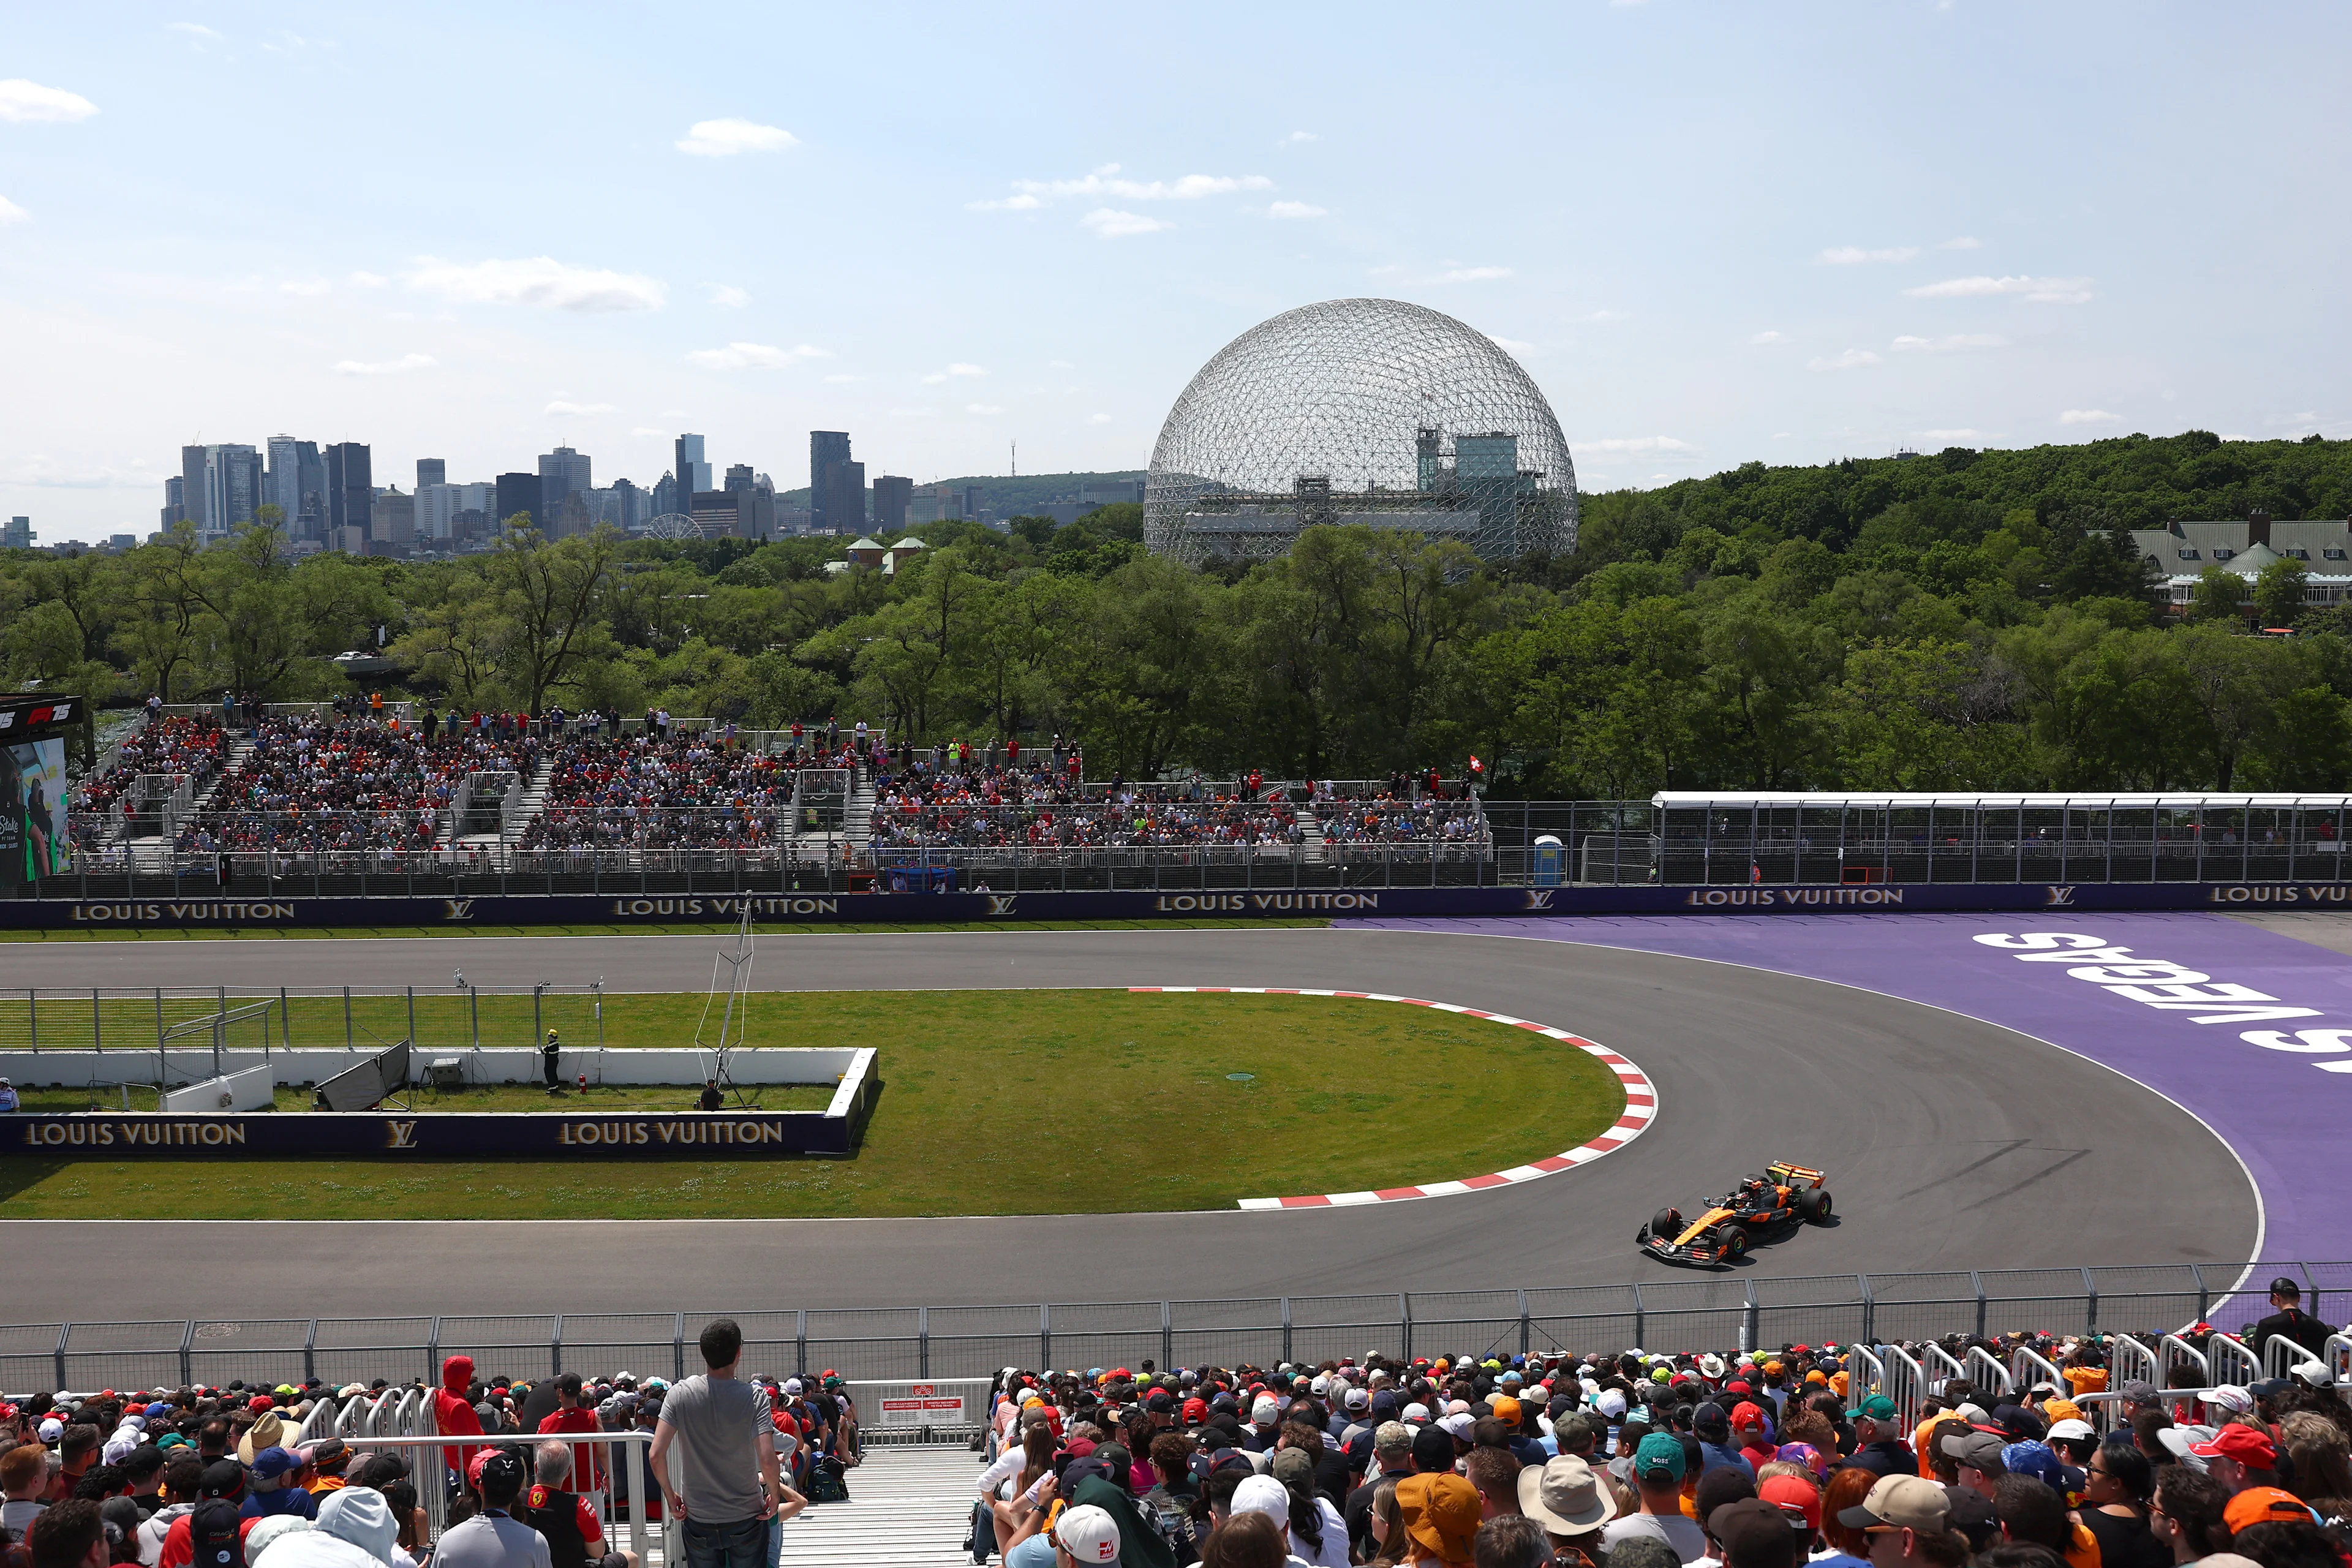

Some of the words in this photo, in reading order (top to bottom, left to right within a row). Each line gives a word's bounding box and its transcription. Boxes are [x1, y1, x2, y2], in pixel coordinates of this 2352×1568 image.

[0, 815, 19, 835] Stake
[1161, 895, 1245, 911] LOUIS
[1254, 894, 1378, 909] VUITTON
[1692, 890, 1774, 905] LOUIS
[1784, 889, 1903, 905] VUITTON
[2214, 887, 2298, 902] LOUIS
[76, 905, 160, 920] LOUIS
[170, 903, 294, 919] VUITTON
[618, 899, 703, 915] LOUIS
[1972, 932, 2325, 1024] VEGAS
[30, 1123, 114, 1145] LOUIS
[123, 1123, 245, 1145] VUITTON
[564, 1122, 649, 1145] LOUIS
[658, 1121, 782, 1144] VUITTON
